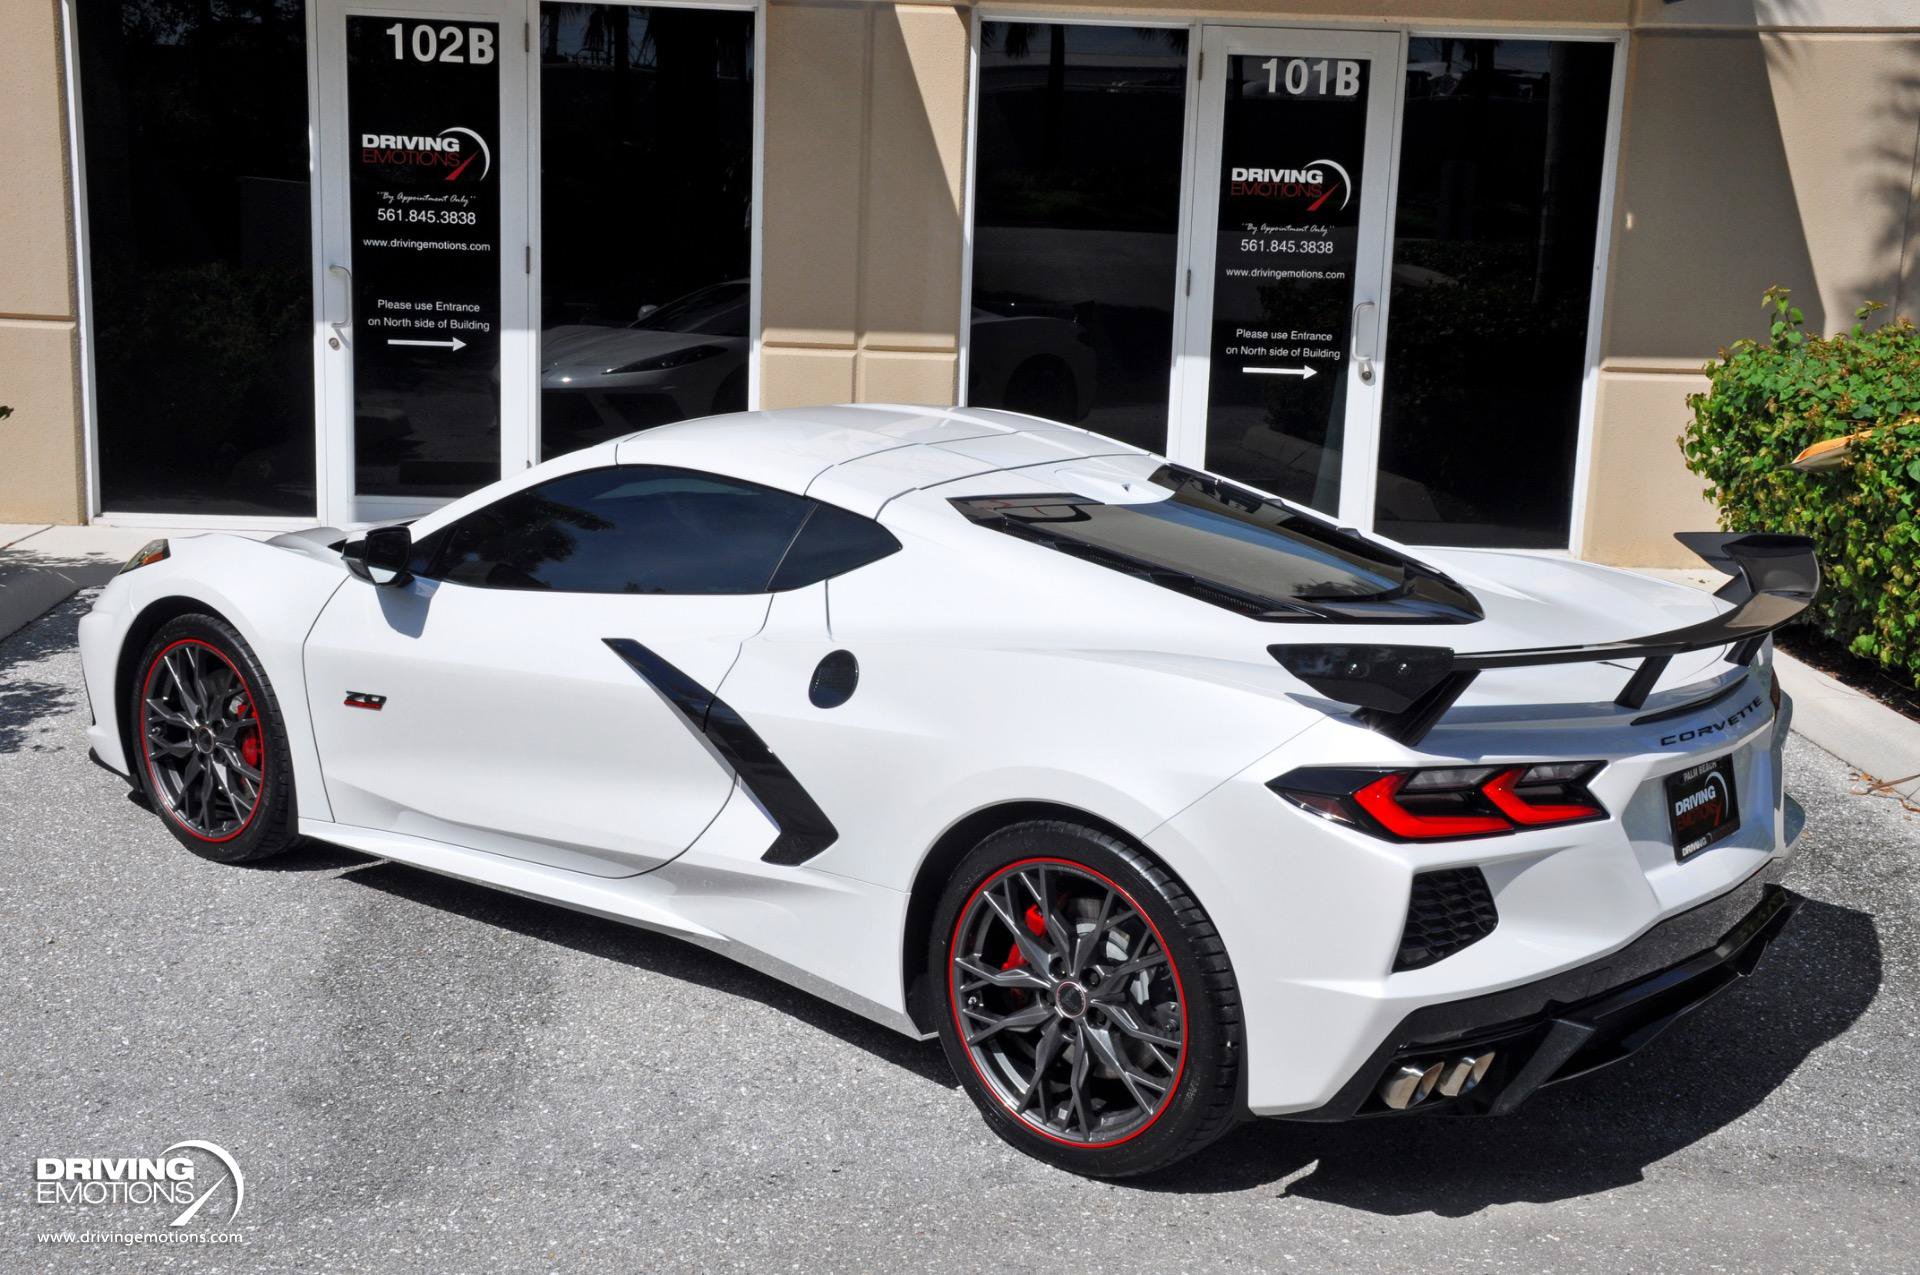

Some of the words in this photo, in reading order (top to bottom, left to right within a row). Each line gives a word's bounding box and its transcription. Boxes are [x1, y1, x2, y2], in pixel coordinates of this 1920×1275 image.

[386, 23, 495, 65] 102B
[1262, 58, 1361, 96] 101B
[362, 134, 460, 152] DRIVING
[362, 151, 461, 167] EMOTIONS
[1231, 167, 1323, 184] DRIVING
[396, 192, 449, 204] Appointment
[1230, 183, 1322, 198] EMOTIONS
[377, 208, 476, 225] 561.845.3838
[1260, 223, 1309, 234] Appointment
[363, 238, 491, 251] www.drivingemotions.com
[1240, 239, 1334, 254] 561.845.3838
[1226, 267, 1345, 280] www.drivingemotions.com
[377, 300, 412, 310] Please
[414, 302, 433, 311] use
[435, 301, 480, 312] Entrance
[367, 318, 381, 327] on
[383, 317, 412, 328] North
[414, 318, 435, 329] side
[437, 319, 449, 329] of
[450, 319, 490, 332] Building
[1236, 328, 1268, 340] Please
[1271, 331, 1288, 340] use
[1290, 330, 1333, 342] Entrance
[1225, 345, 1238, 355] on
[1240, 345, 1267, 356] North
[1269, 345, 1289, 356] side
[1290, 347, 1301, 357] of
[1302, 347, 1341, 361] Building
[1660, 695, 1762, 747] CORVETTE
[1683, 768, 1699, 782] PALM
[1675, 785, 1716, 817] DRIVING
